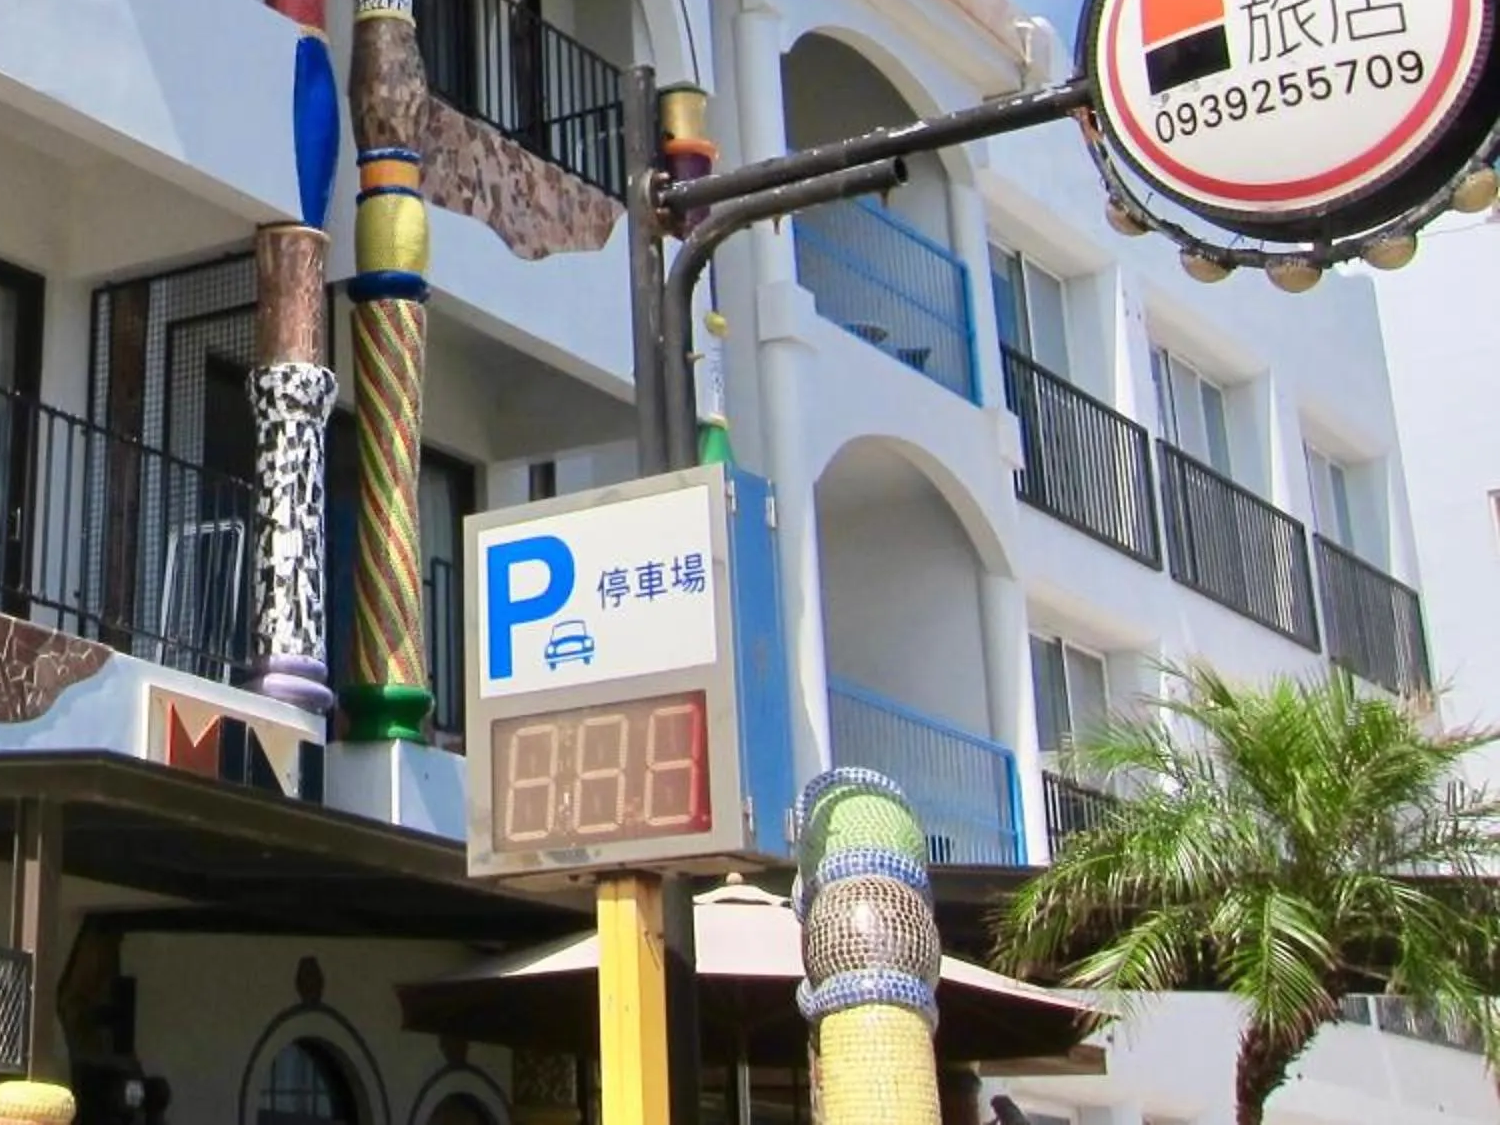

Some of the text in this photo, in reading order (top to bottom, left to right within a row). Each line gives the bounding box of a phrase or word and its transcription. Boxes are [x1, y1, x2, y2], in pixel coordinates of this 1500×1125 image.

[1155, 50, 1425, 143] 0939255709
[486, 535, 707, 681] P 停車場
